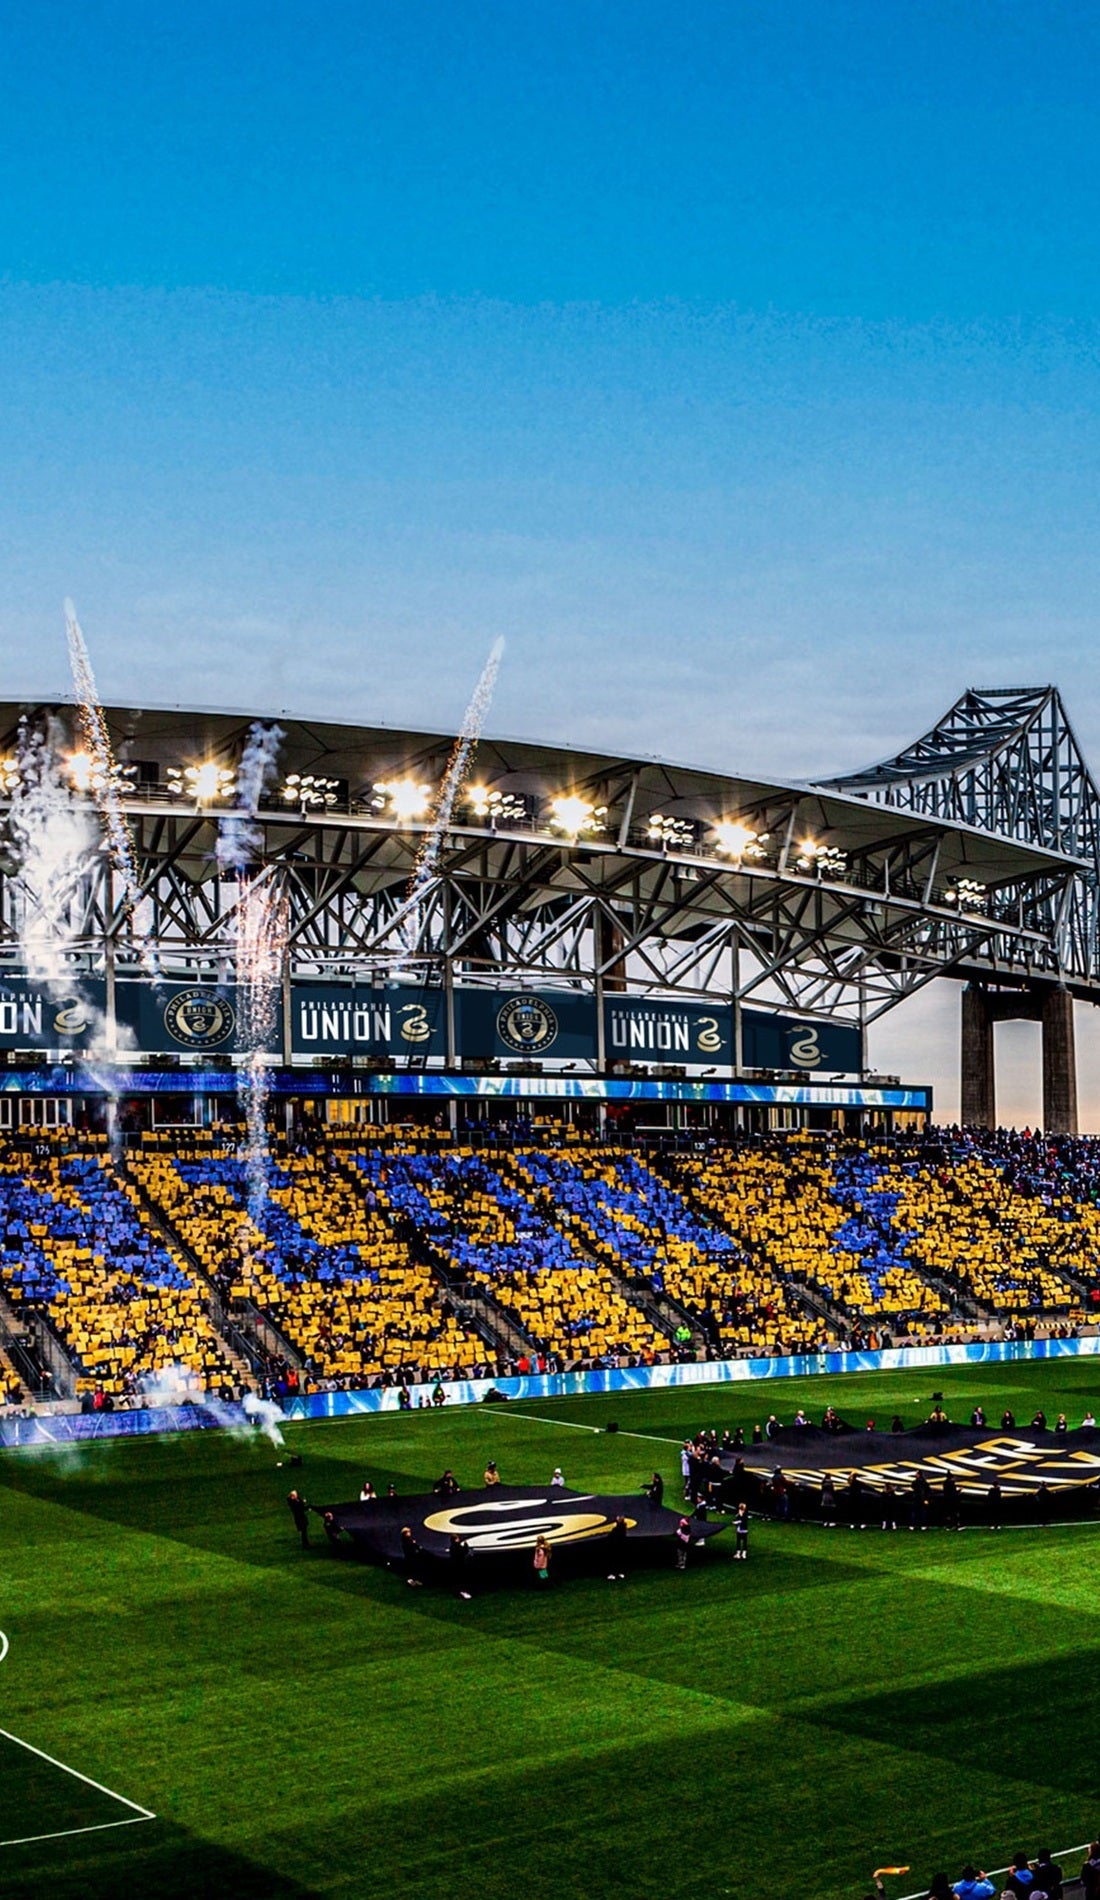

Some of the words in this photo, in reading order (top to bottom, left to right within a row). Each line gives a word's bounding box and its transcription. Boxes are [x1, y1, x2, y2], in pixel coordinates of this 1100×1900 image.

[168, 991, 230, 1016] PHILADELPHIA
[301, 1001, 390, 1011] PHILADELPHIA
[501, 999, 554, 1024] PHILADELPHIA
[301, 1010, 391, 1041] UNION
[611, 1010, 689, 1023] PHILADELPHIA
[612, 1019, 689, 1051] UNION
